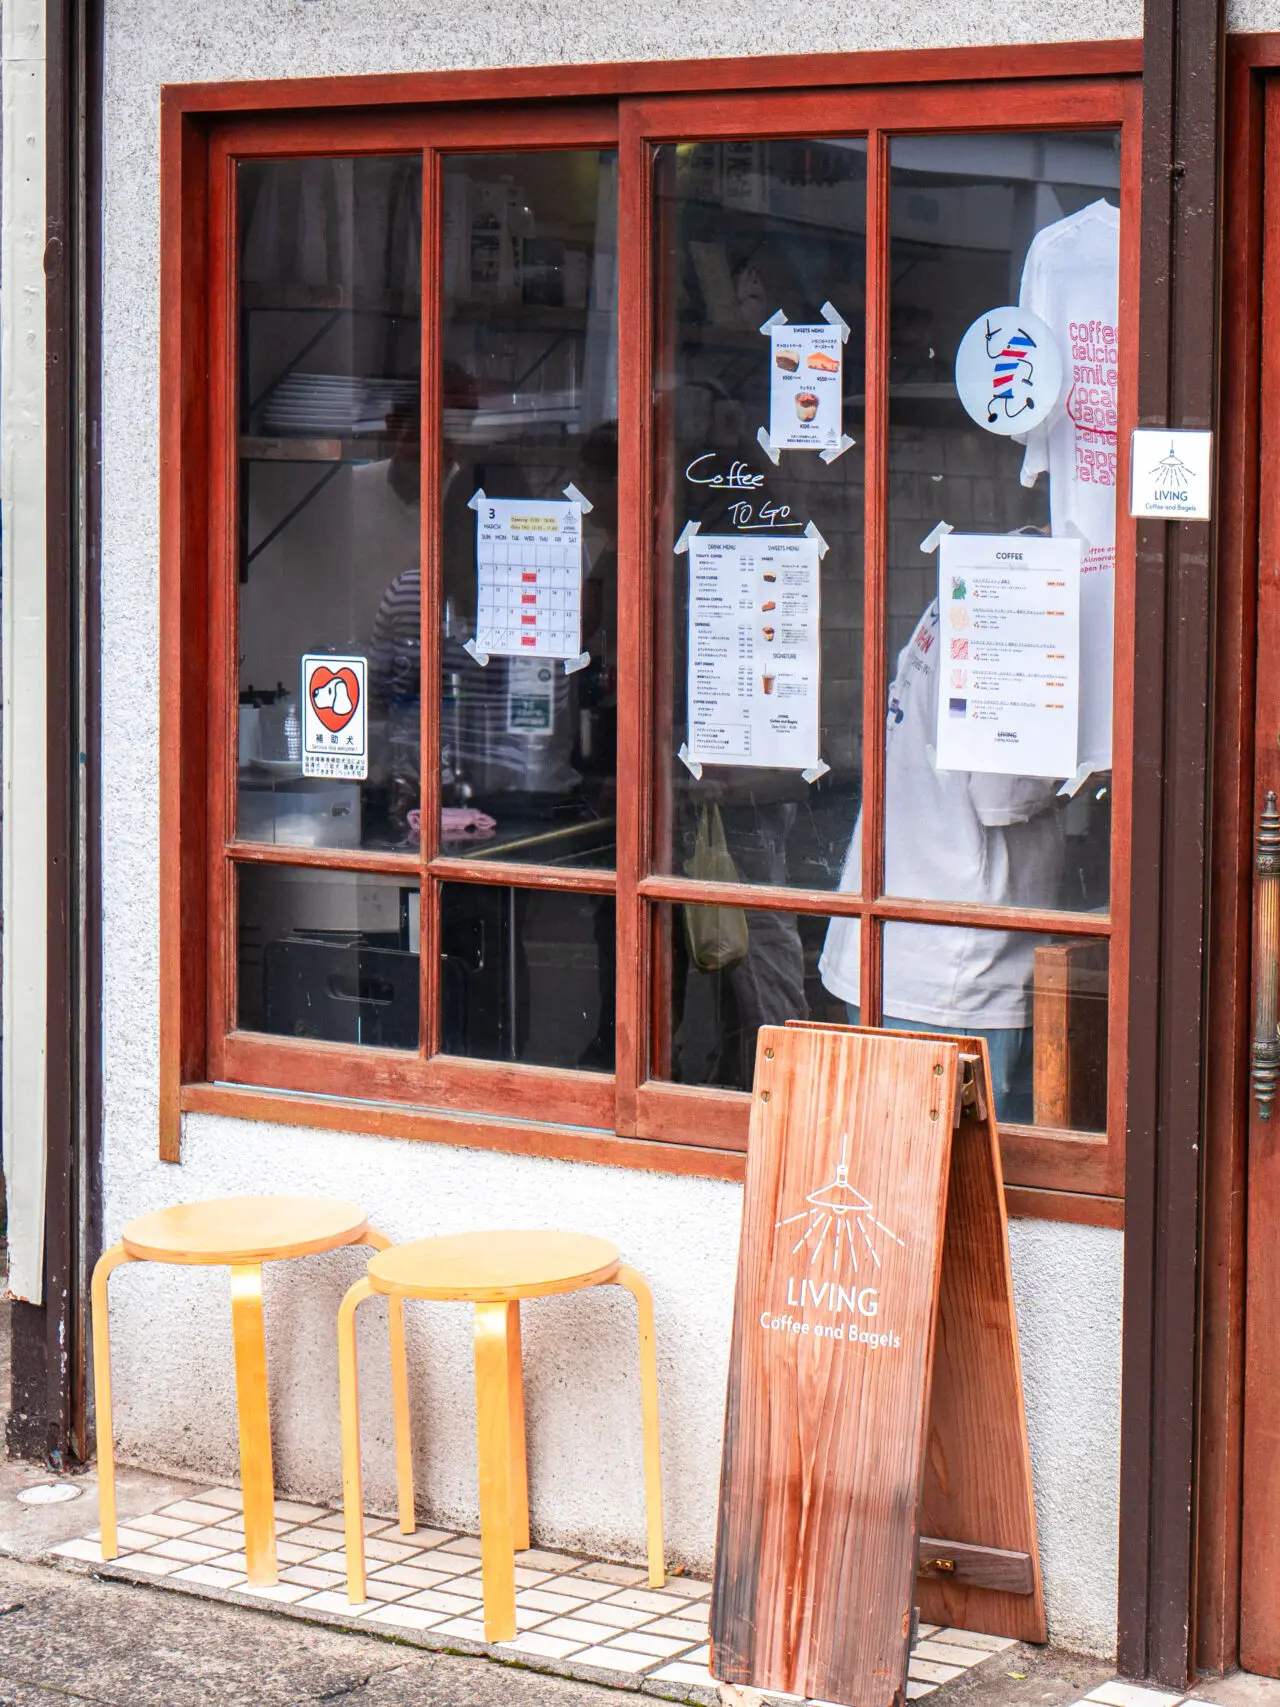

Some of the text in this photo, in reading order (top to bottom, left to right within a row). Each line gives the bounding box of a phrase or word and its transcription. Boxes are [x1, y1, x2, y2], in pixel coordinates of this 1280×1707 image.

[686, 453, 764, 486] Coffee
[1154, 490, 1188, 501] LIVING
[488, 508, 496, 519] 3
[728, 501, 752, 524] TO
[1145, 502, 1163, 511] Coffee
[1177, 504, 1196, 513] Bagels
[996, 552, 1023, 560] COFFEE
[316, 733, 354, 745] 補助犬
[786, 1277, 879, 1317] LIVING
[760, 1311, 901, 1350] Coffee and Bagels
